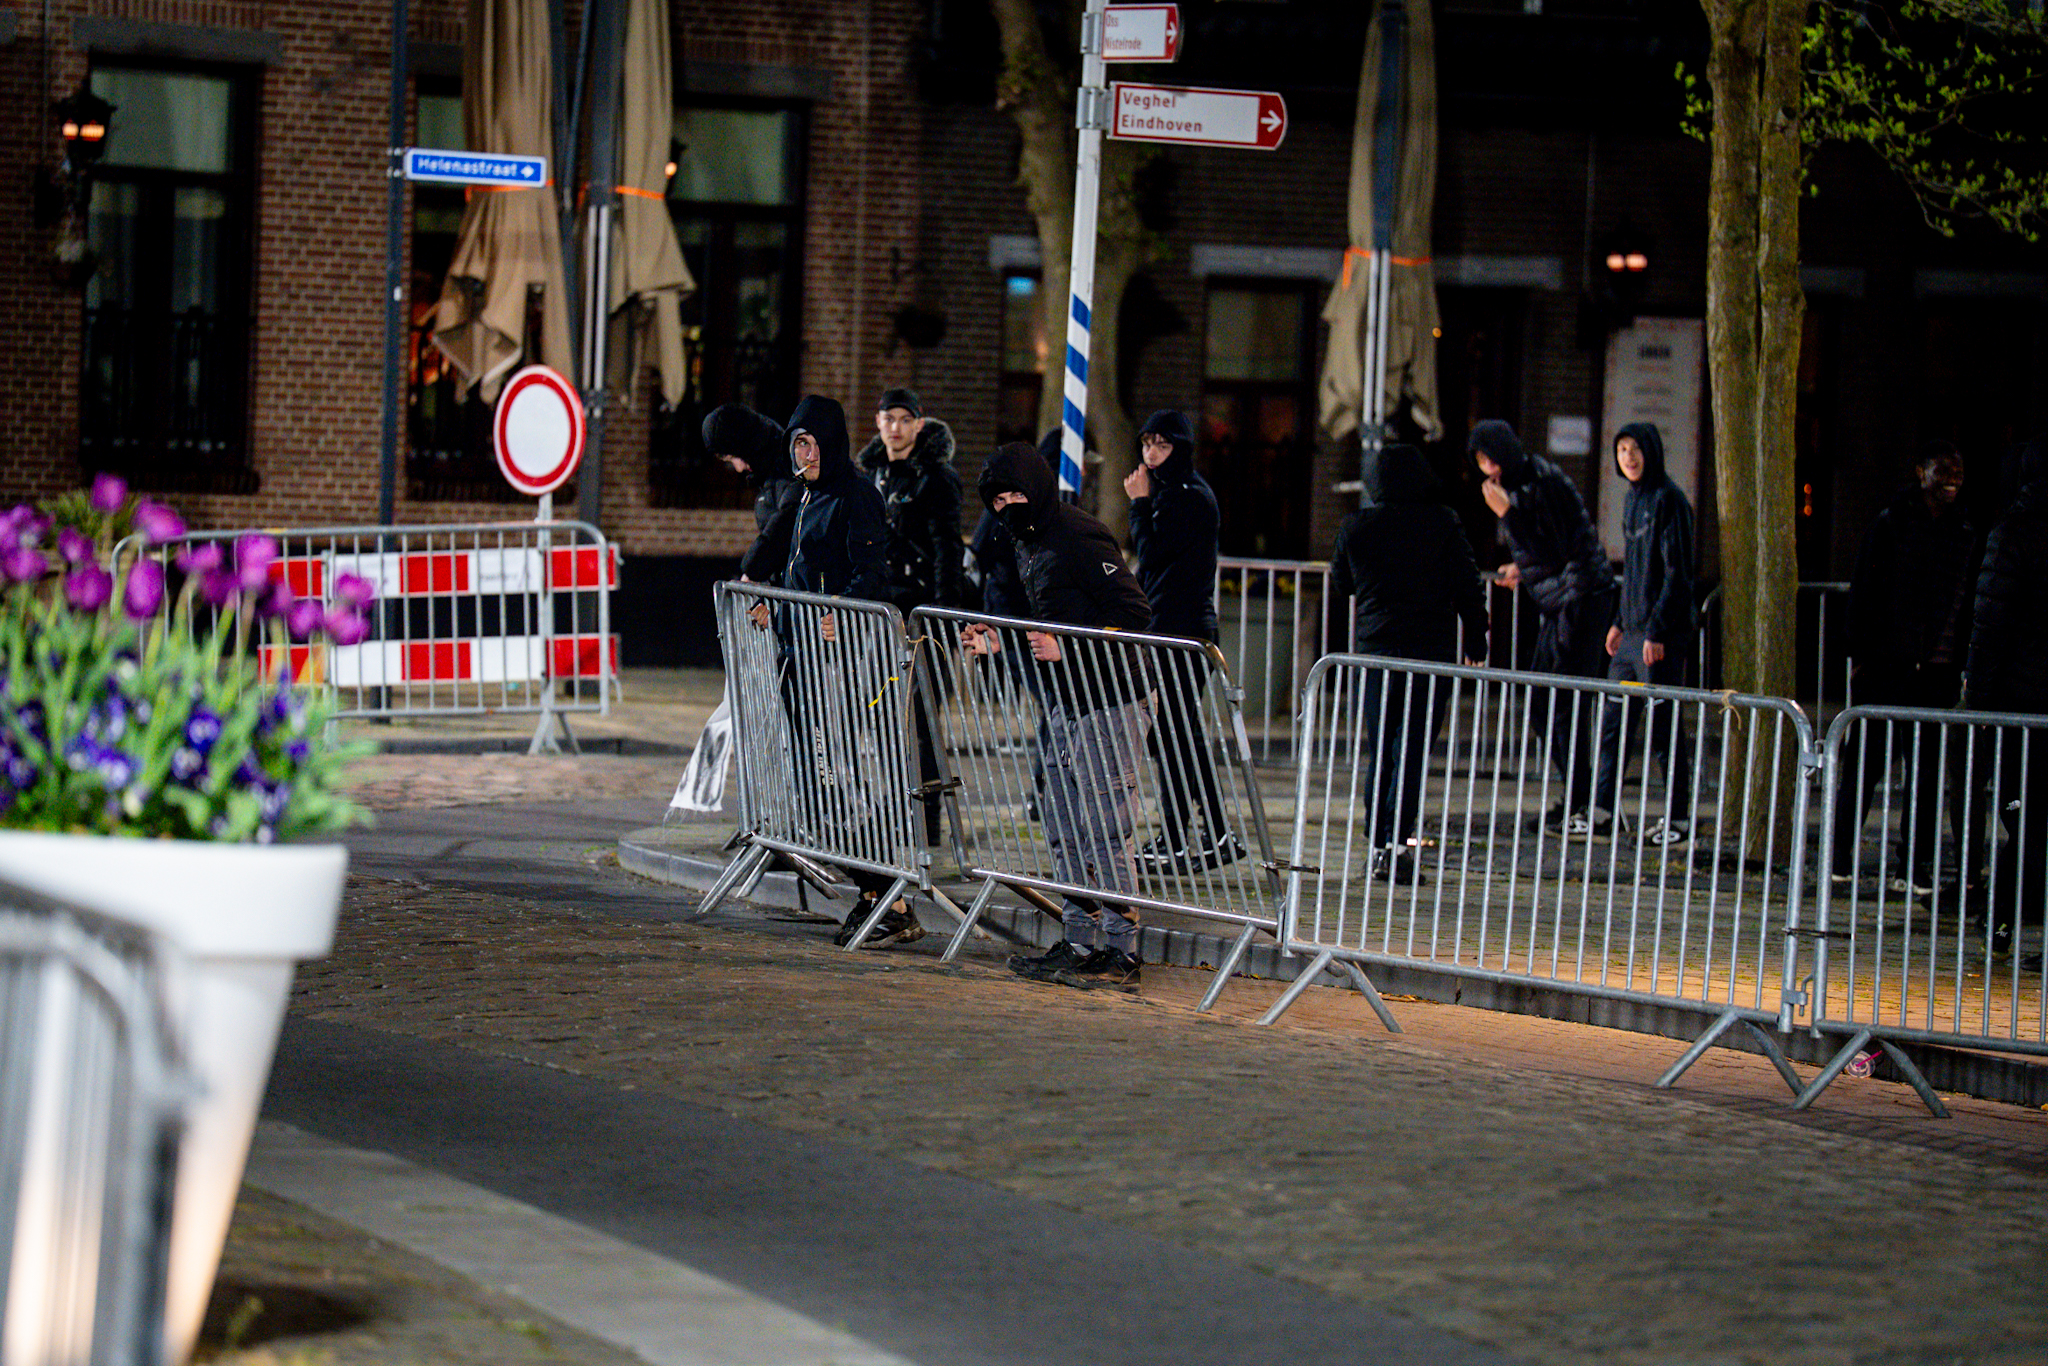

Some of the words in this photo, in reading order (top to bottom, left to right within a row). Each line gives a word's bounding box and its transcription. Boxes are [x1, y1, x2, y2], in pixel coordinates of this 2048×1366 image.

[1105, 14, 1119, 28] Oss
[1104, 37, 1142, 51] Nistelrode
[1122, 92, 1177, 110] Veghel
[1121, 114, 1203, 133] Eindhoven
[417, 156, 518, 177] Helenastraat
